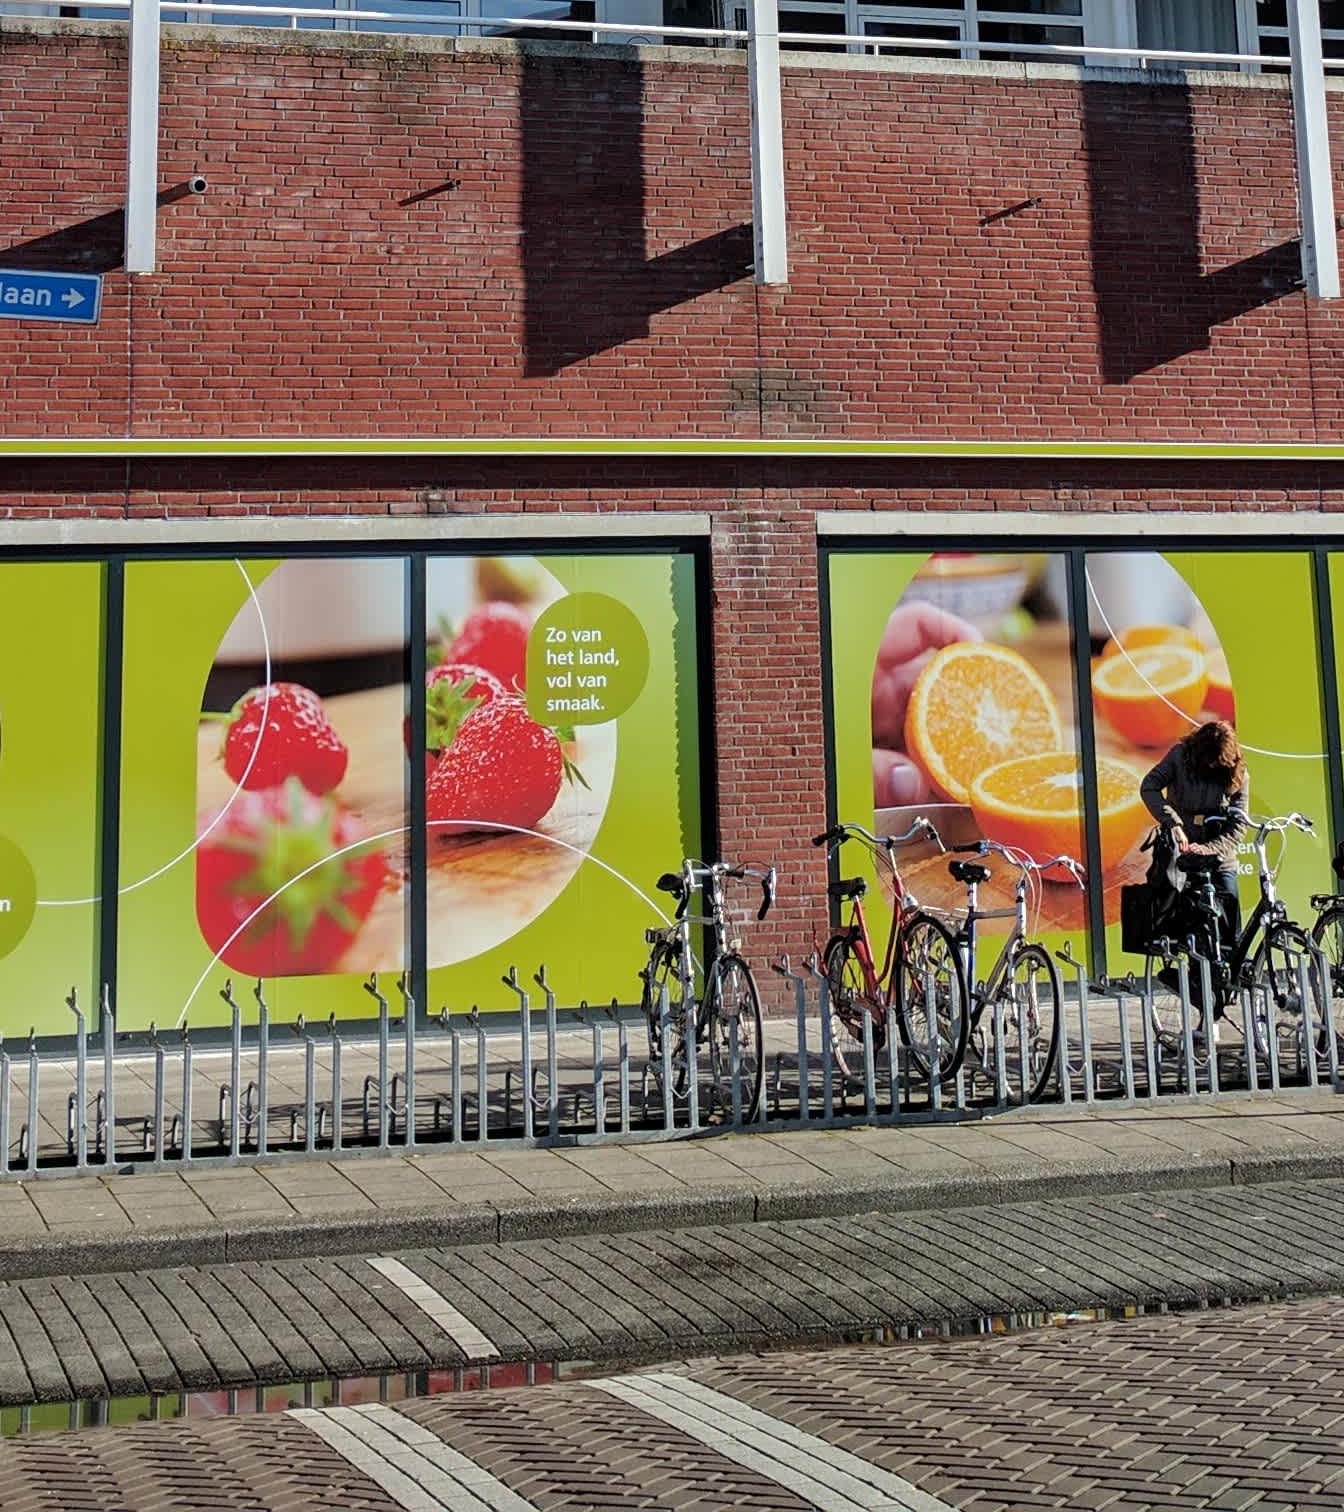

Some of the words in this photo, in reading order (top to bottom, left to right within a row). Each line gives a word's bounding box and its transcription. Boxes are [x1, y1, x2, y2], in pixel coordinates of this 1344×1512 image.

[545, 626, 567, 643] Zo
[571, 628, 602, 643] van
[546, 649, 574, 666] het
[578, 647, 620, 666] land,
[545, 671, 572, 688] vol
[576, 673, 607, 688] van
[545, 694, 605, 712] smaak.
